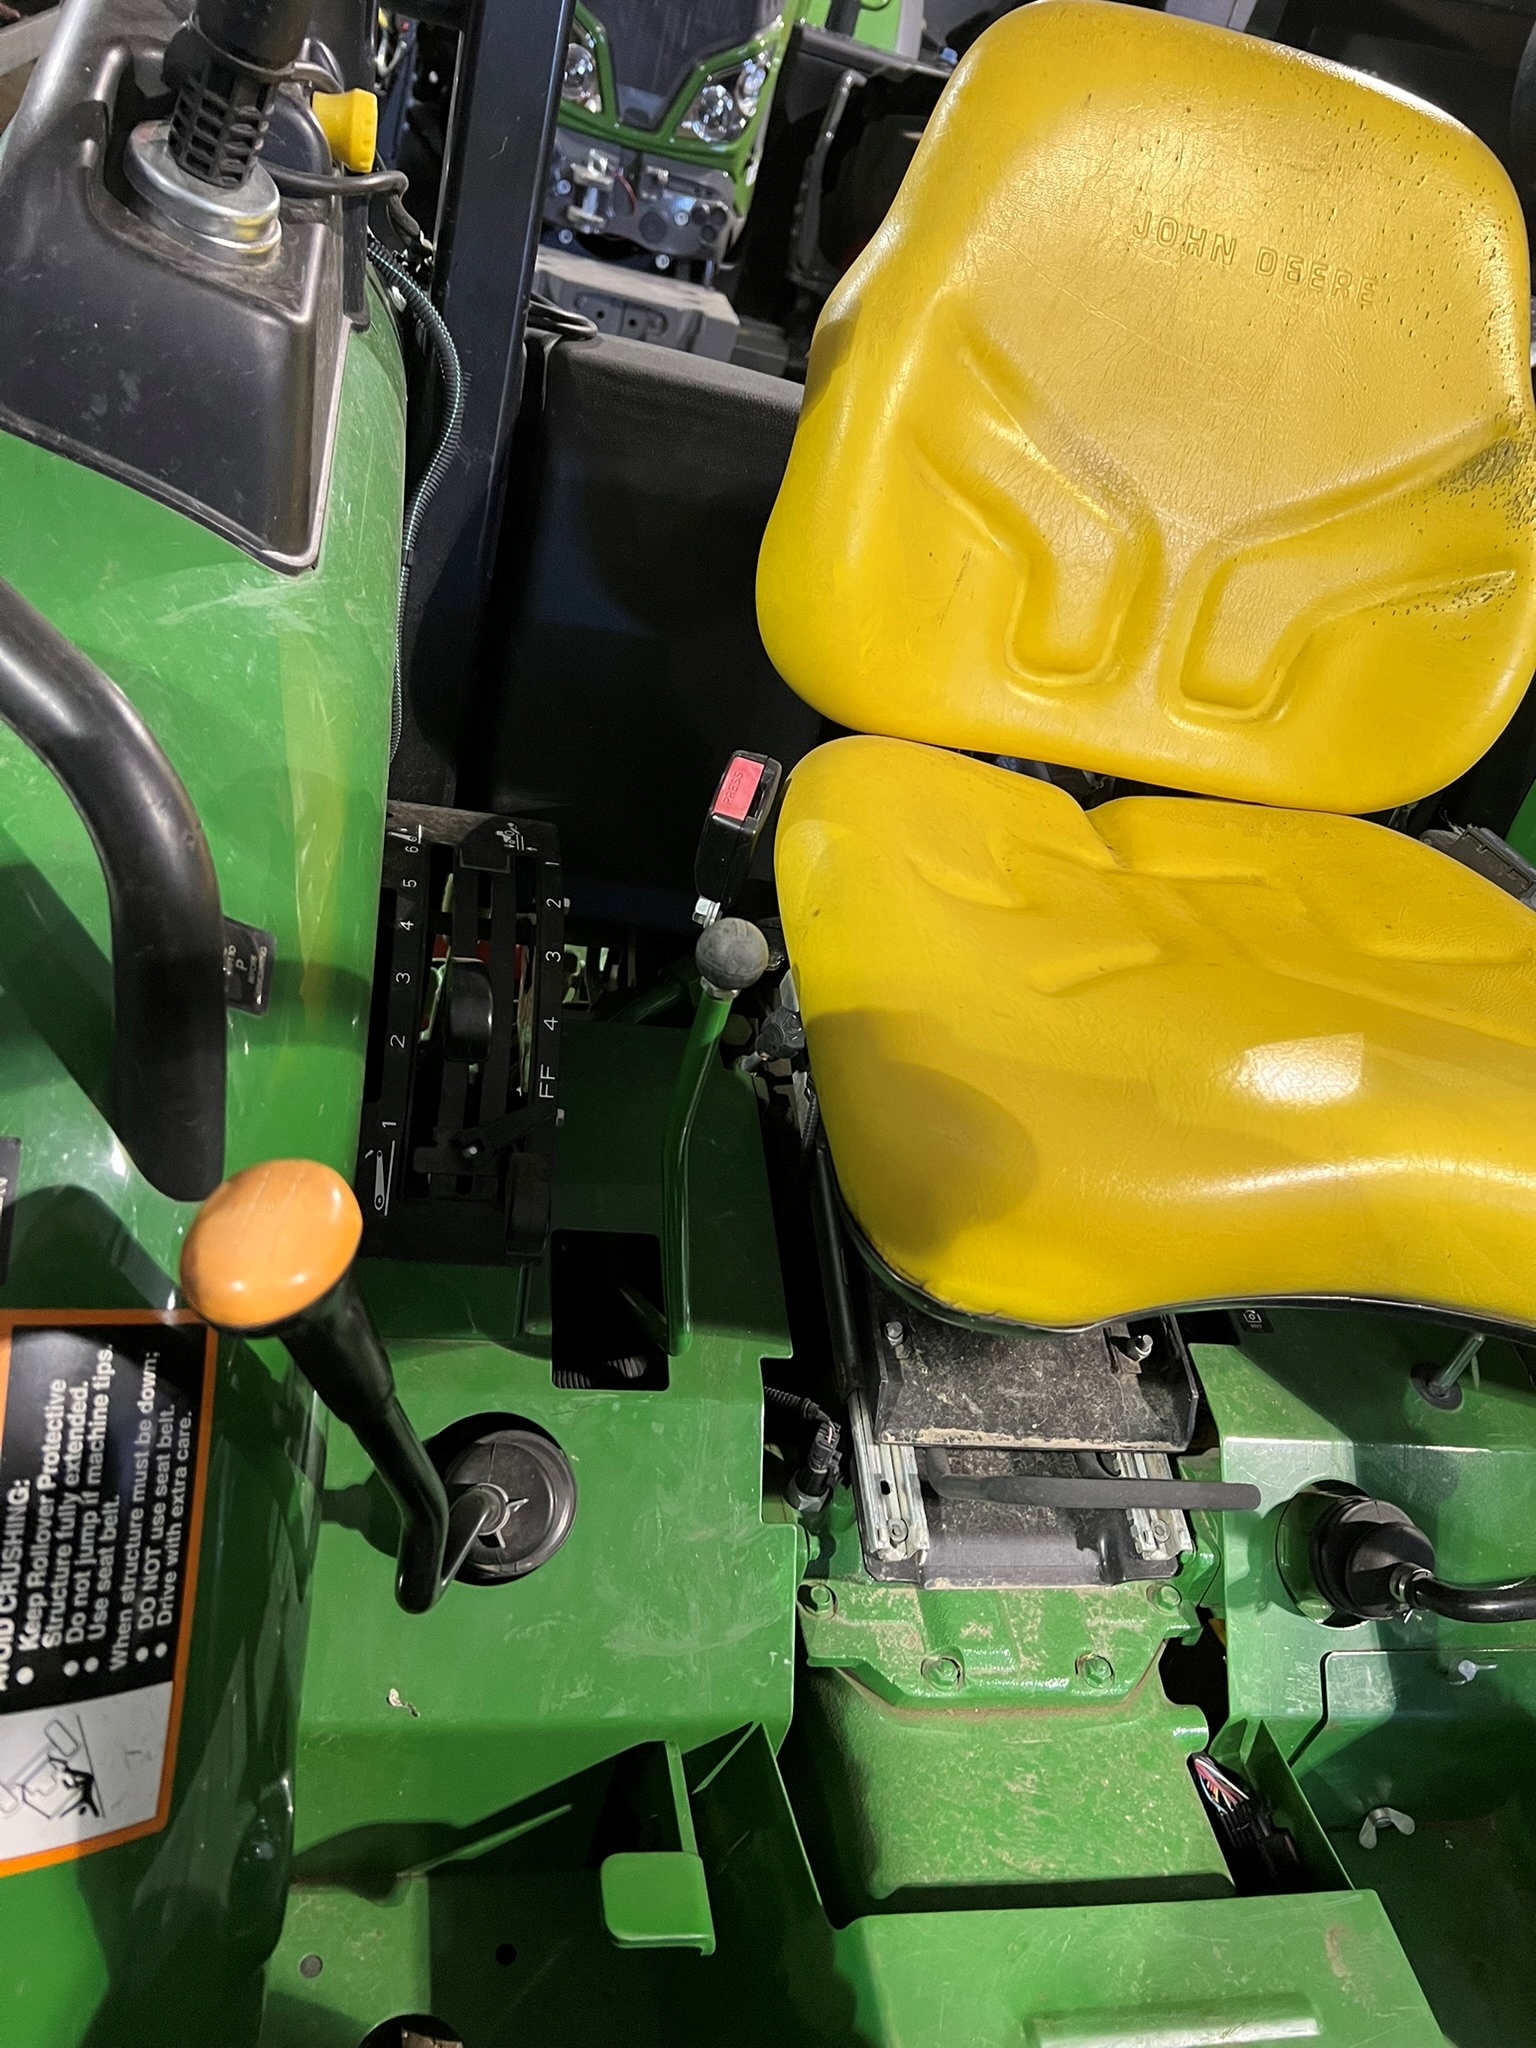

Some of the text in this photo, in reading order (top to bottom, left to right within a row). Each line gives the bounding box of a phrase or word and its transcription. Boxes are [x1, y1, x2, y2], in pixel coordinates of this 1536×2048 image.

[1131, 211, 1379, 306] JOHN DEERE
[722, 770, 744, 806] PRESS
[546, 898, 562, 909] 2
[381, 845, 419, 1129] 1 2 3 4 5 6
[545, 951, 561, 963] 3
[543, 1016, 559, 1031] 4
[132, 1449, 150, 1502] must
[134, 1419, 152, 1445] be
[17, 1378, 67, 1650] Keep Rollover Protective
[41, 1380, 89, 1648] Structure fully extended.
[65, 1344, 115, 1644] Do not jump if machine tips.
[137, 1403, 175, 1630] DO NOT use seat belt.
[157, 1411, 193, 1626] Drive with extra care.
[0, 1479, 31, 1613] CRUSHING:
[86, 1494, 120, 1641] Use seat belt.
[120, 1507, 144, 1603] structure
[109, 1608, 133, 1672] When
